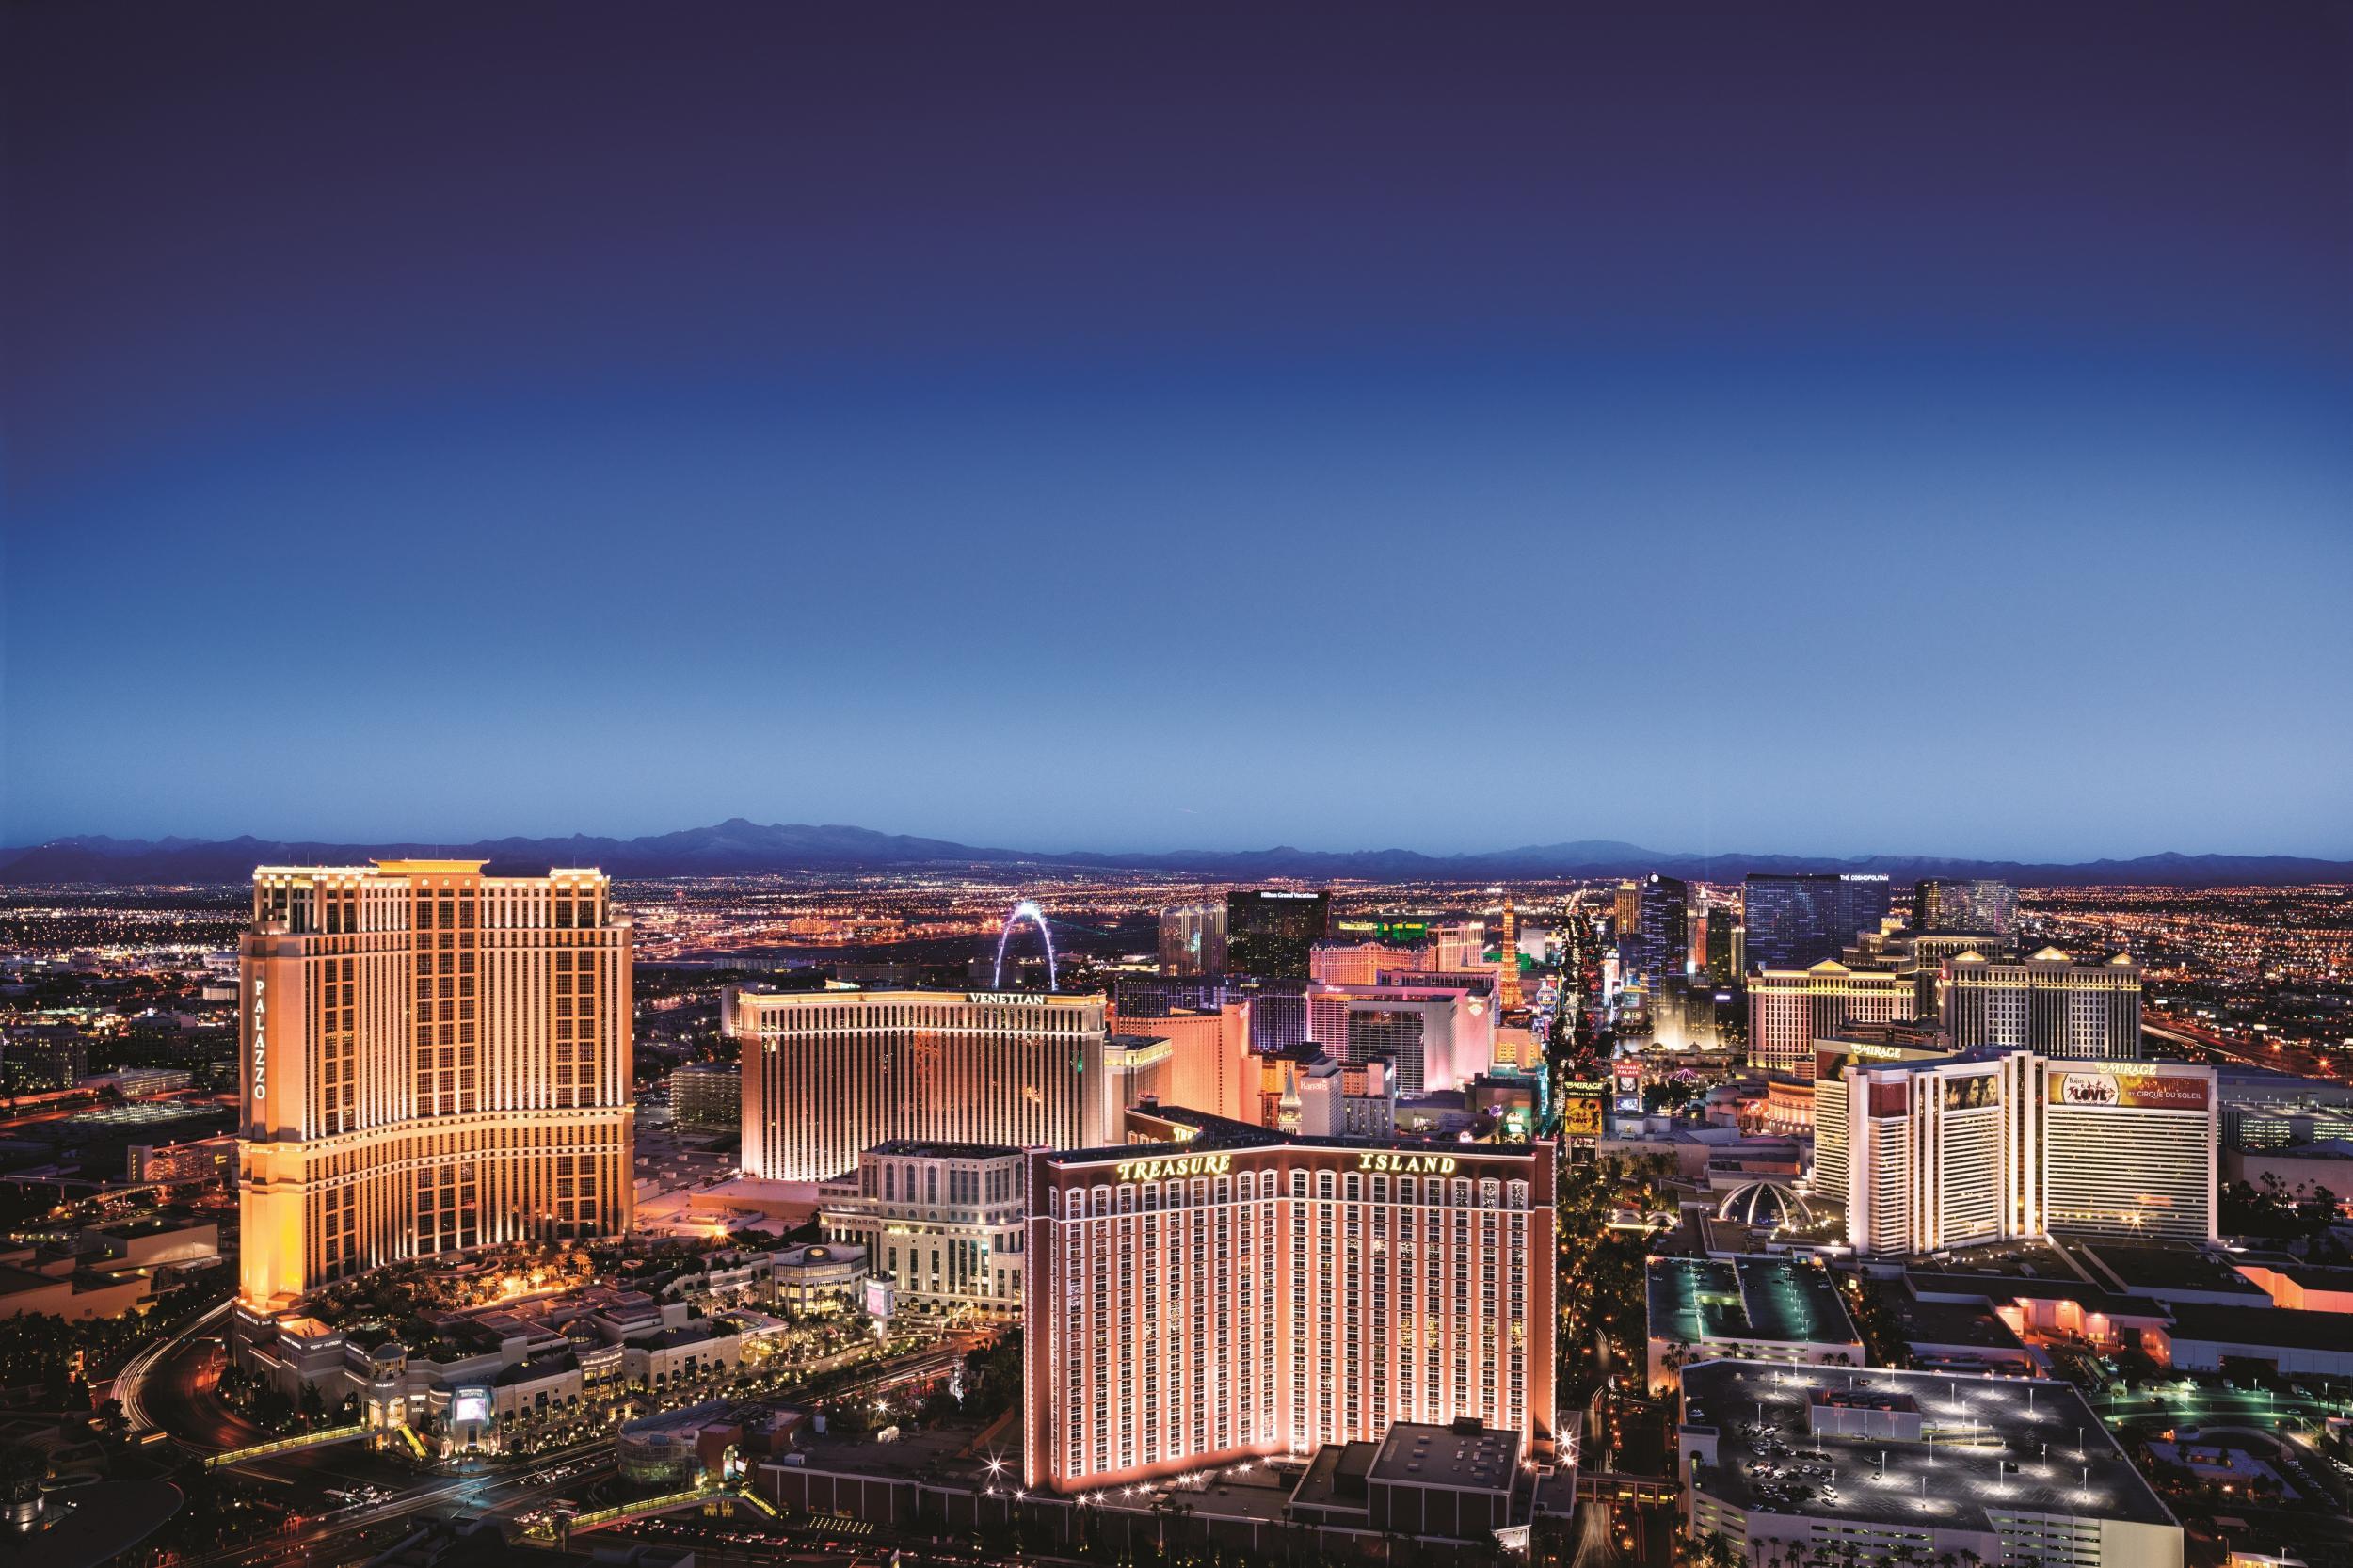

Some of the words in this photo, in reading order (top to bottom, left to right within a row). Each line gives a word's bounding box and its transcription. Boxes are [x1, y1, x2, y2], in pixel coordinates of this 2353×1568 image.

[969, 993, 1045, 1005] VENETIAN
[253, 980, 266, 1100] PALAZZO
[1854, 1044, 1901, 1058] MIRAGE
[2100, 1064, 2157, 1076] MIRAGE
[2073, 1088, 2107, 1101] LOVE
[2137, 1090, 2163, 1098] CIRQUE
[1117, 1155, 1231, 1180] TREASURE
[1359, 1154, 1455, 1173] ISLAND
